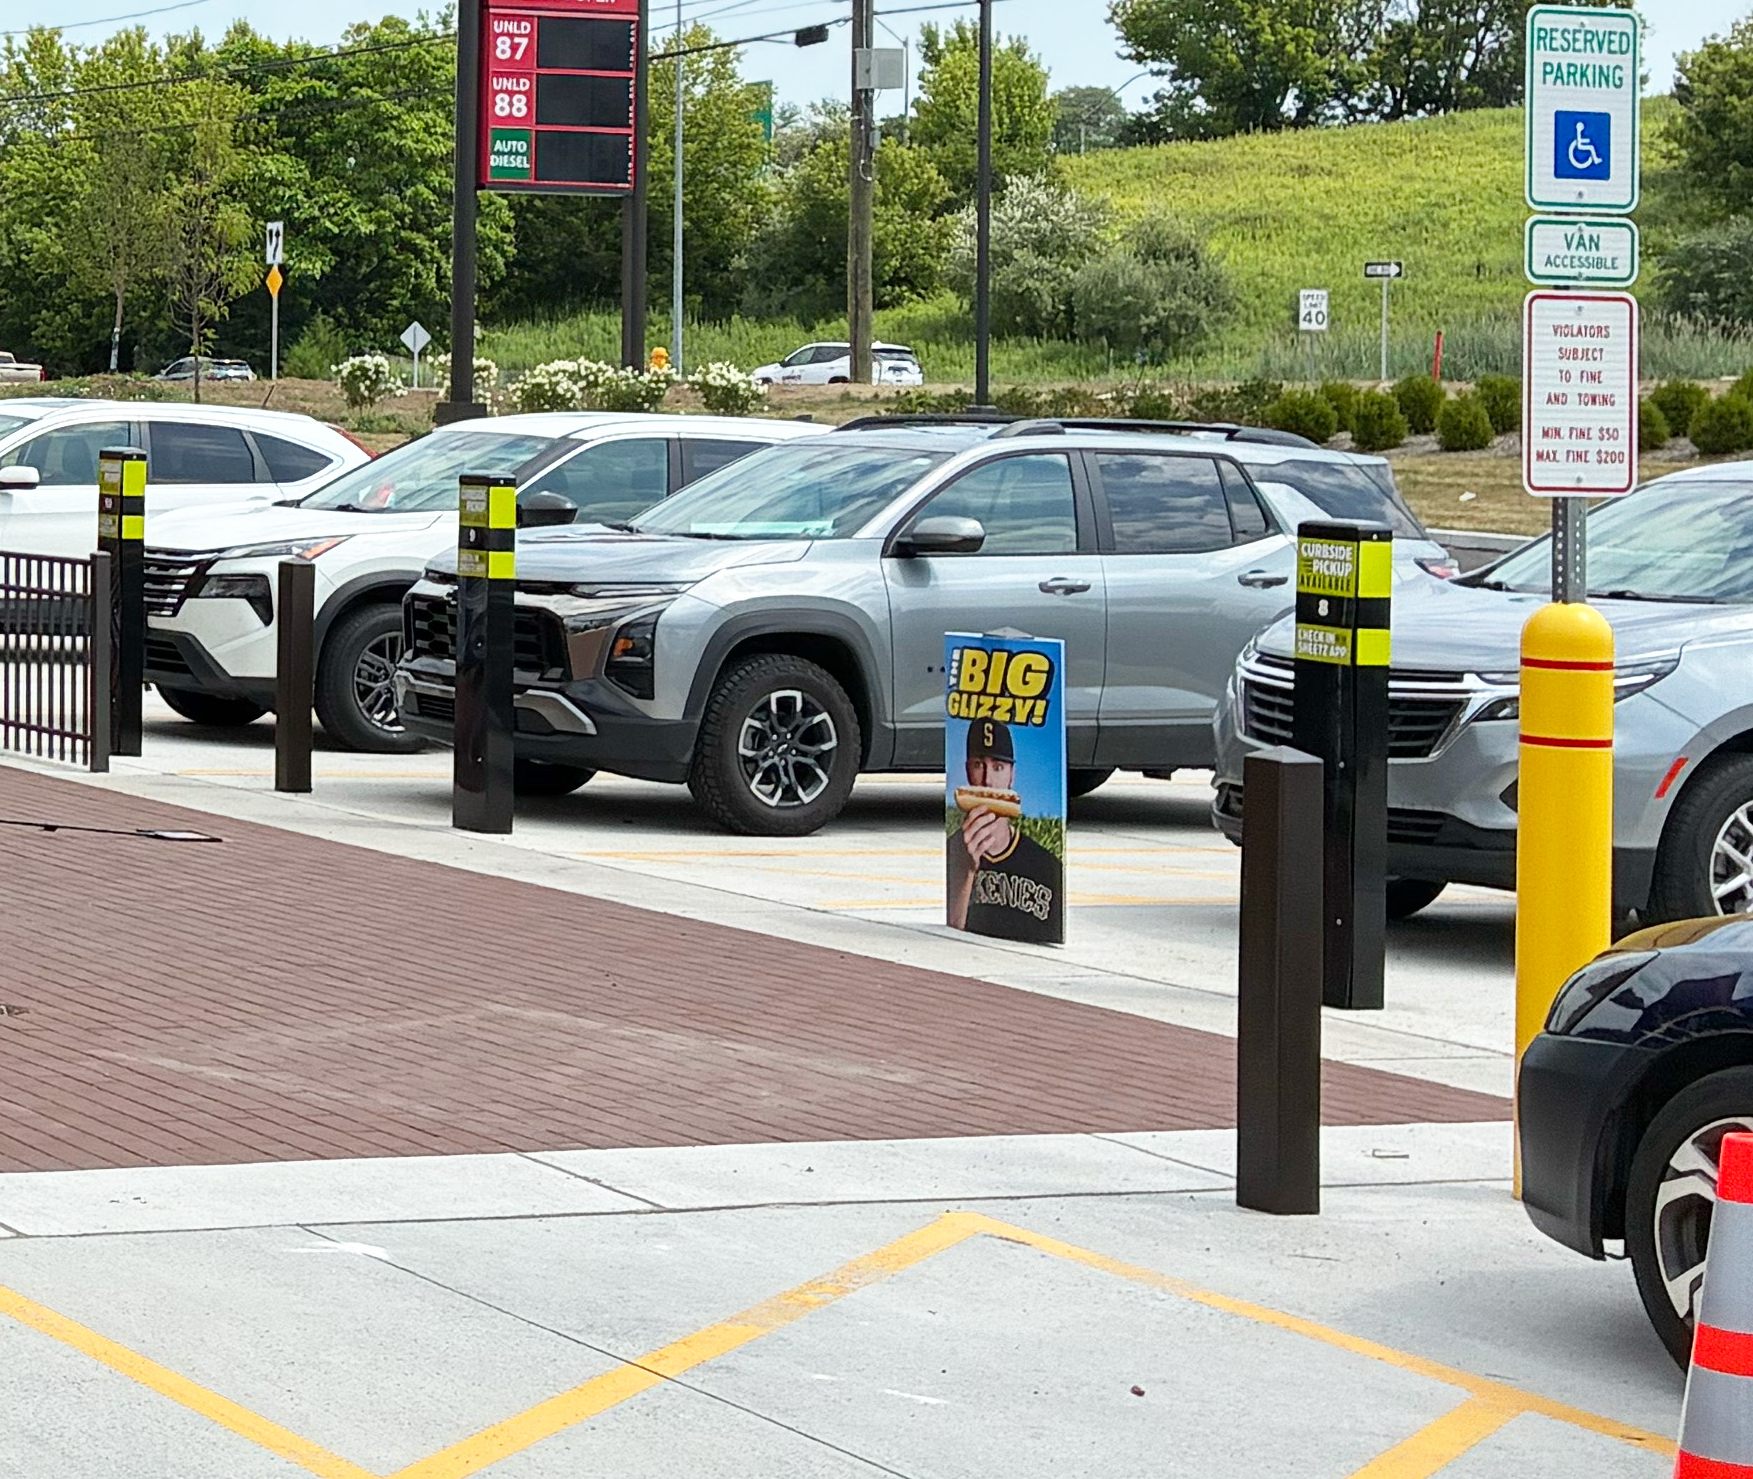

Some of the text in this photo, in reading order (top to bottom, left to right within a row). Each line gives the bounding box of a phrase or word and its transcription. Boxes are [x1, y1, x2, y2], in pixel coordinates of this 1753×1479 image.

[493, 20, 531, 34] UNLD
[495, 36, 529, 60] 87
[1536, 27, 1630, 55] RESERVED
[1542, 61, 1624, 89] PARKING
[492, 77, 531, 91] UNLD
[494, 93, 527, 118] 88
[494, 140, 527, 153] AUTO
[489, 154, 531, 169] DIESEL
[1564, 232, 1601, 253] VAN
[1545, 255, 1619, 270] ACCESSIBLE
[1303, 311, 1325, 325] 40
[1552, 324, 1610, 338] VIOLATORS
[1558, 347, 1604, 361] SUBJECT
[1559, 369, 1603, 384] TO FINE
[1546, 392, 1616, 407] AND TOWING
[1569, 426, 1592, 440] FINE
[1598, 426, 1619, 441] $50
[1566, 449, 1590, 463] FINE
[1596, 449, 1625, 465] $200
[1301, 542, 1353, 562] CURBSIDE
[1312, 559, 1353, 577] PICKUP
[959, 648, 1050, 697] BIG
[948, 692, 1047, 724] GLIZZY!
[984, 723, 993, 747] S
[975, 870, 1053, 920] KENES
